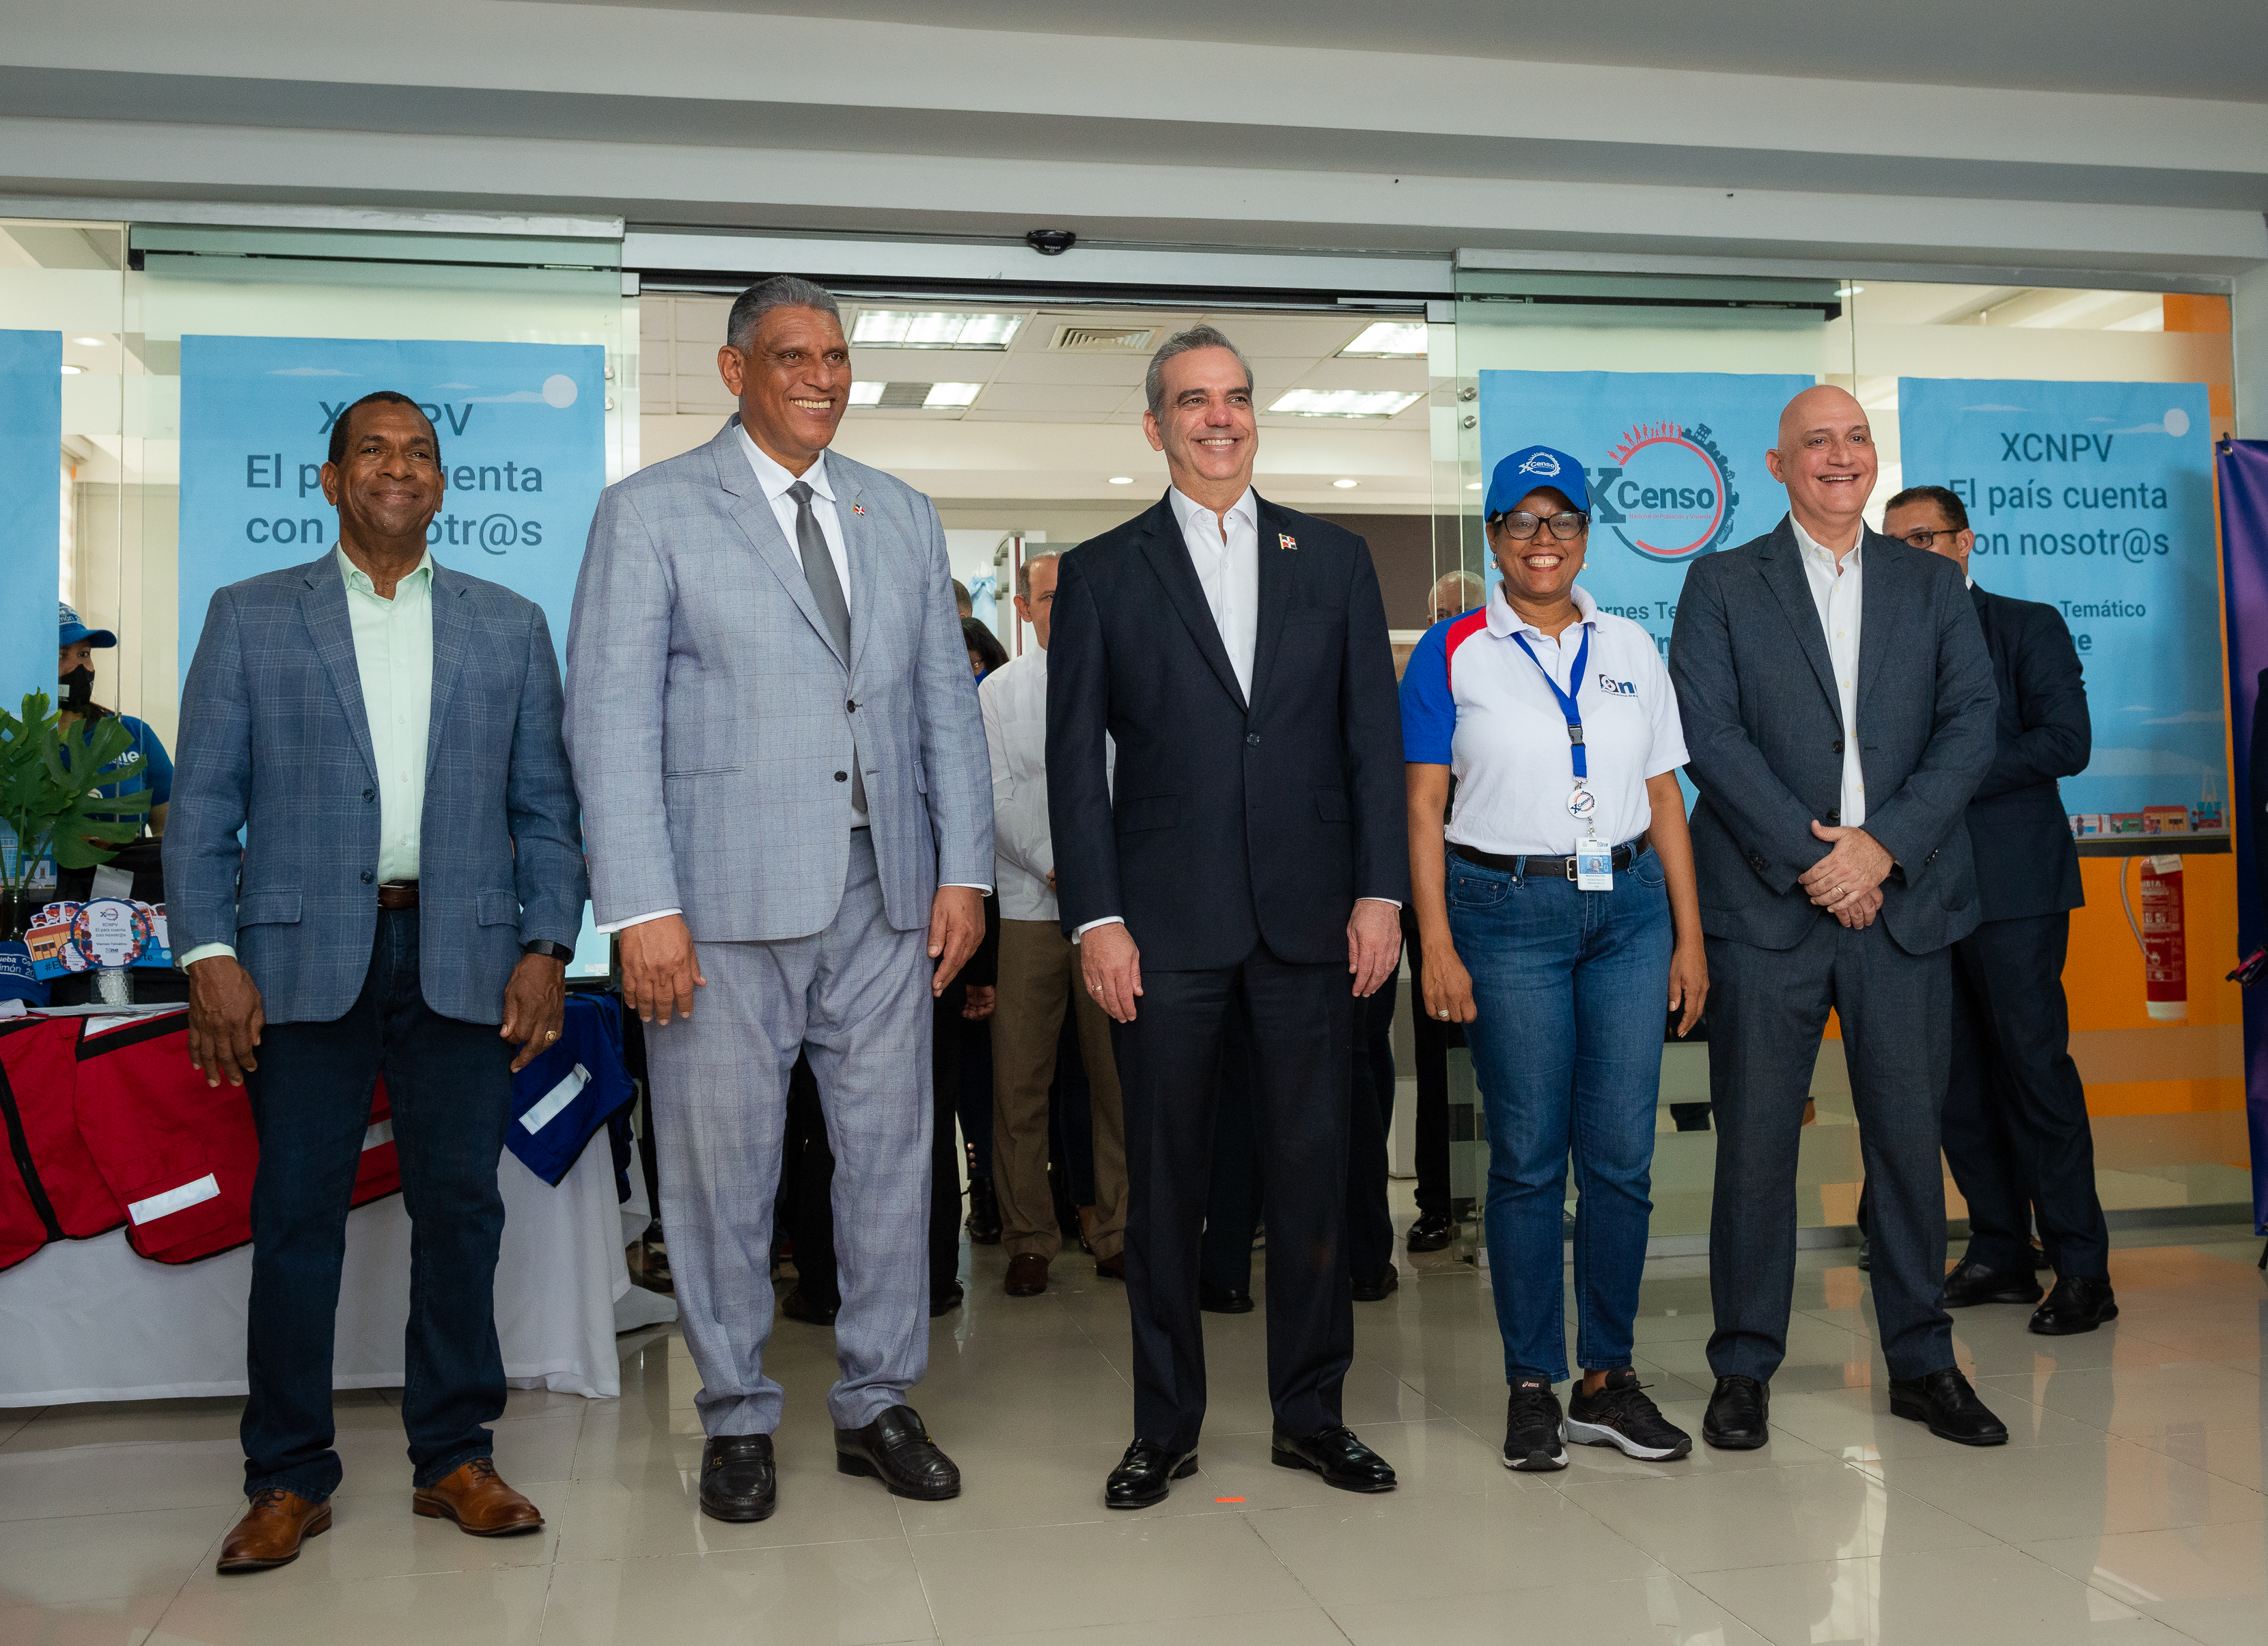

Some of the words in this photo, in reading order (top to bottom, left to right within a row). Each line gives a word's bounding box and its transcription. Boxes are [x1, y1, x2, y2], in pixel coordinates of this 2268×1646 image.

[318, 402, 473, 436] XPV
[2001, 433, 2114, 462] XCNPV
[247, 454, 281, 489] El
[445, 461, 542, 492] enta
[1618, 480, 1715, 509] Censo
[1950, 478, 1976, 508] El
[1989, 479, 2053, 515] país
[2064, 482, 2168, 508] cuenta
[246, 517, 323, 544] con
[427, 514, 542, 555] otr@s
[1972, 533, 2010, 555] on
[2020, 529, 2170, 563] nosotr@s
[1596, 605, 1649, 620] rnes
[2060, 599, 2146, 617] Temático
